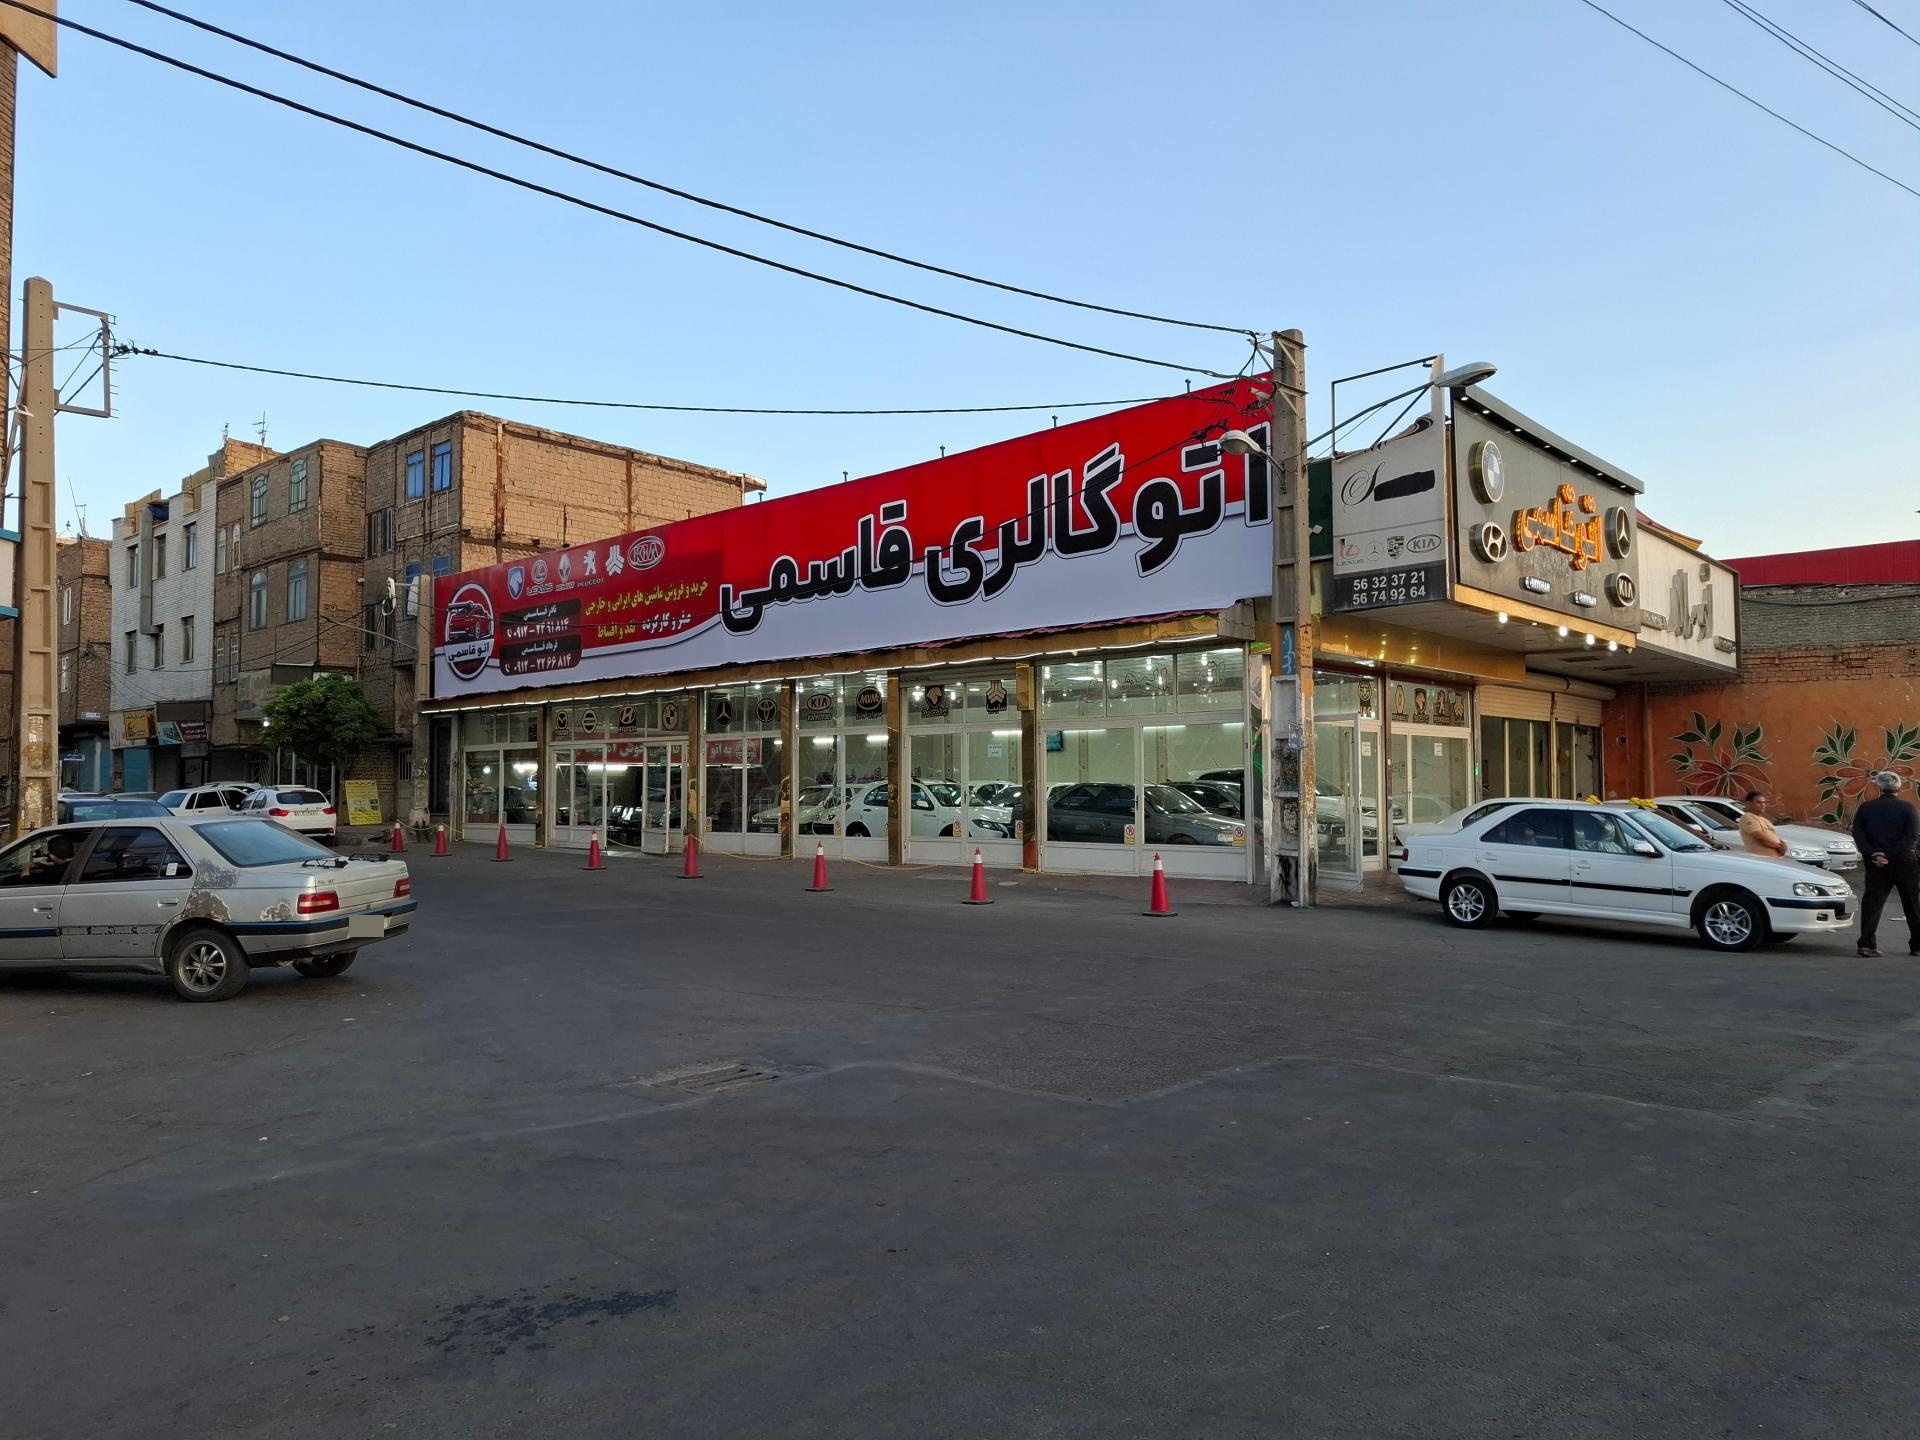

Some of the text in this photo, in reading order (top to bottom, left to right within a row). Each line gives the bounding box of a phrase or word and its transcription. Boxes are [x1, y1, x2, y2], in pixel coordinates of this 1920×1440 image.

[1515, 483, 1577, 554] قاسمی
[719, 422, 1272, 637] اتو گالری قاسمی
[632, 543, 659, 562] KIA
[1413, 538, 1436, 549] KIA
[664, 580, 684, 601] فروش
[690, 577, 709, 597] خرید
[1353, 570, 1426, 591] 56 32 37 21
[612, 592, 631, 611] ایرانی
[1352, 585, 1426, 605] 56 74 92 64
[585, 596, 606, 616] خارجی
[449, 641, 490, 661] اتو قاسمی
[811, 698, 828, 709] KIA
